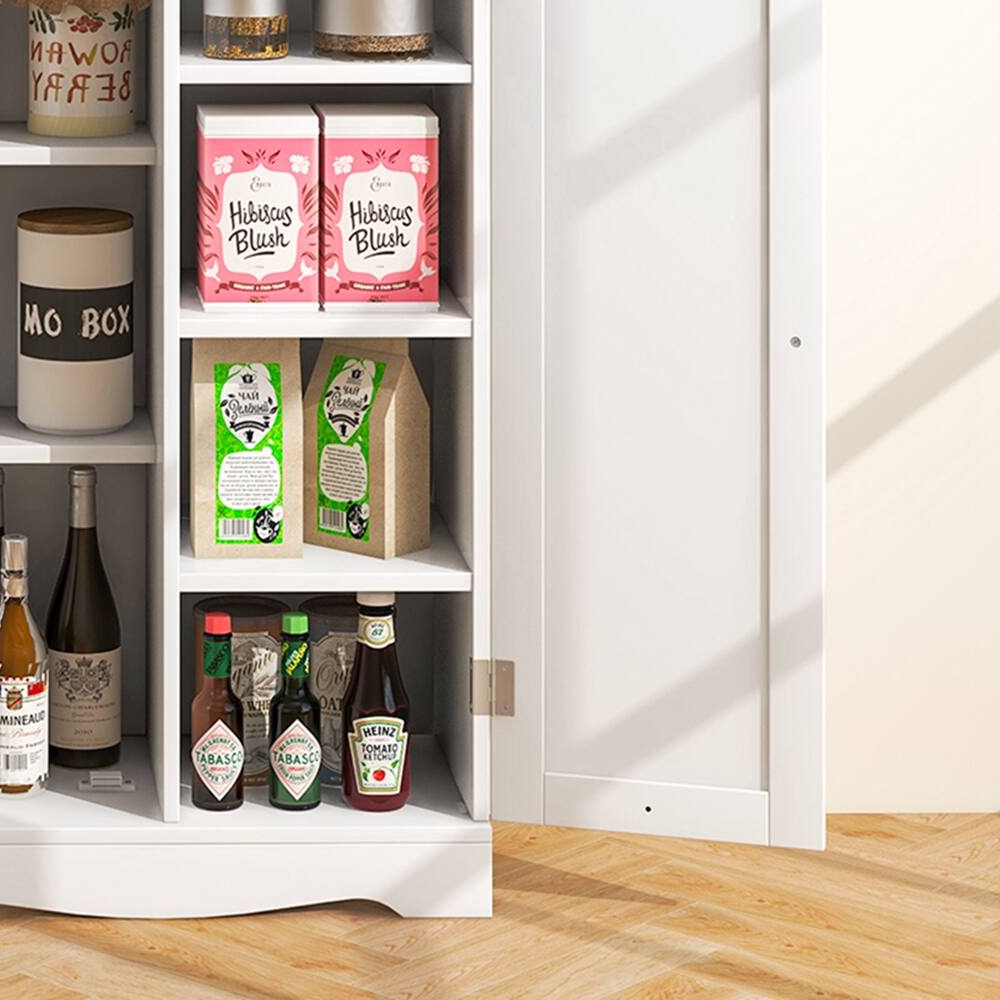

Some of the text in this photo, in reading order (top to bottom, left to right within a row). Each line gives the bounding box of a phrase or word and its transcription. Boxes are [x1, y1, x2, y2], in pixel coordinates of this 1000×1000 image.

[229, 200, 293, 230] Hibiscus
[349, 200, 413, 230] Hibiscus
[228, 226, 290, 255] Blush
[348, 226, 410, 255] Blush
[24, 303, 130, 340] MO BOX
[362, 726, 396, 737] HEINZ
[196, 751, 242, 765] TABASCO
[273, 751, 319, 765] TABASCO
[361, 743, 398, 753] TOMATO
